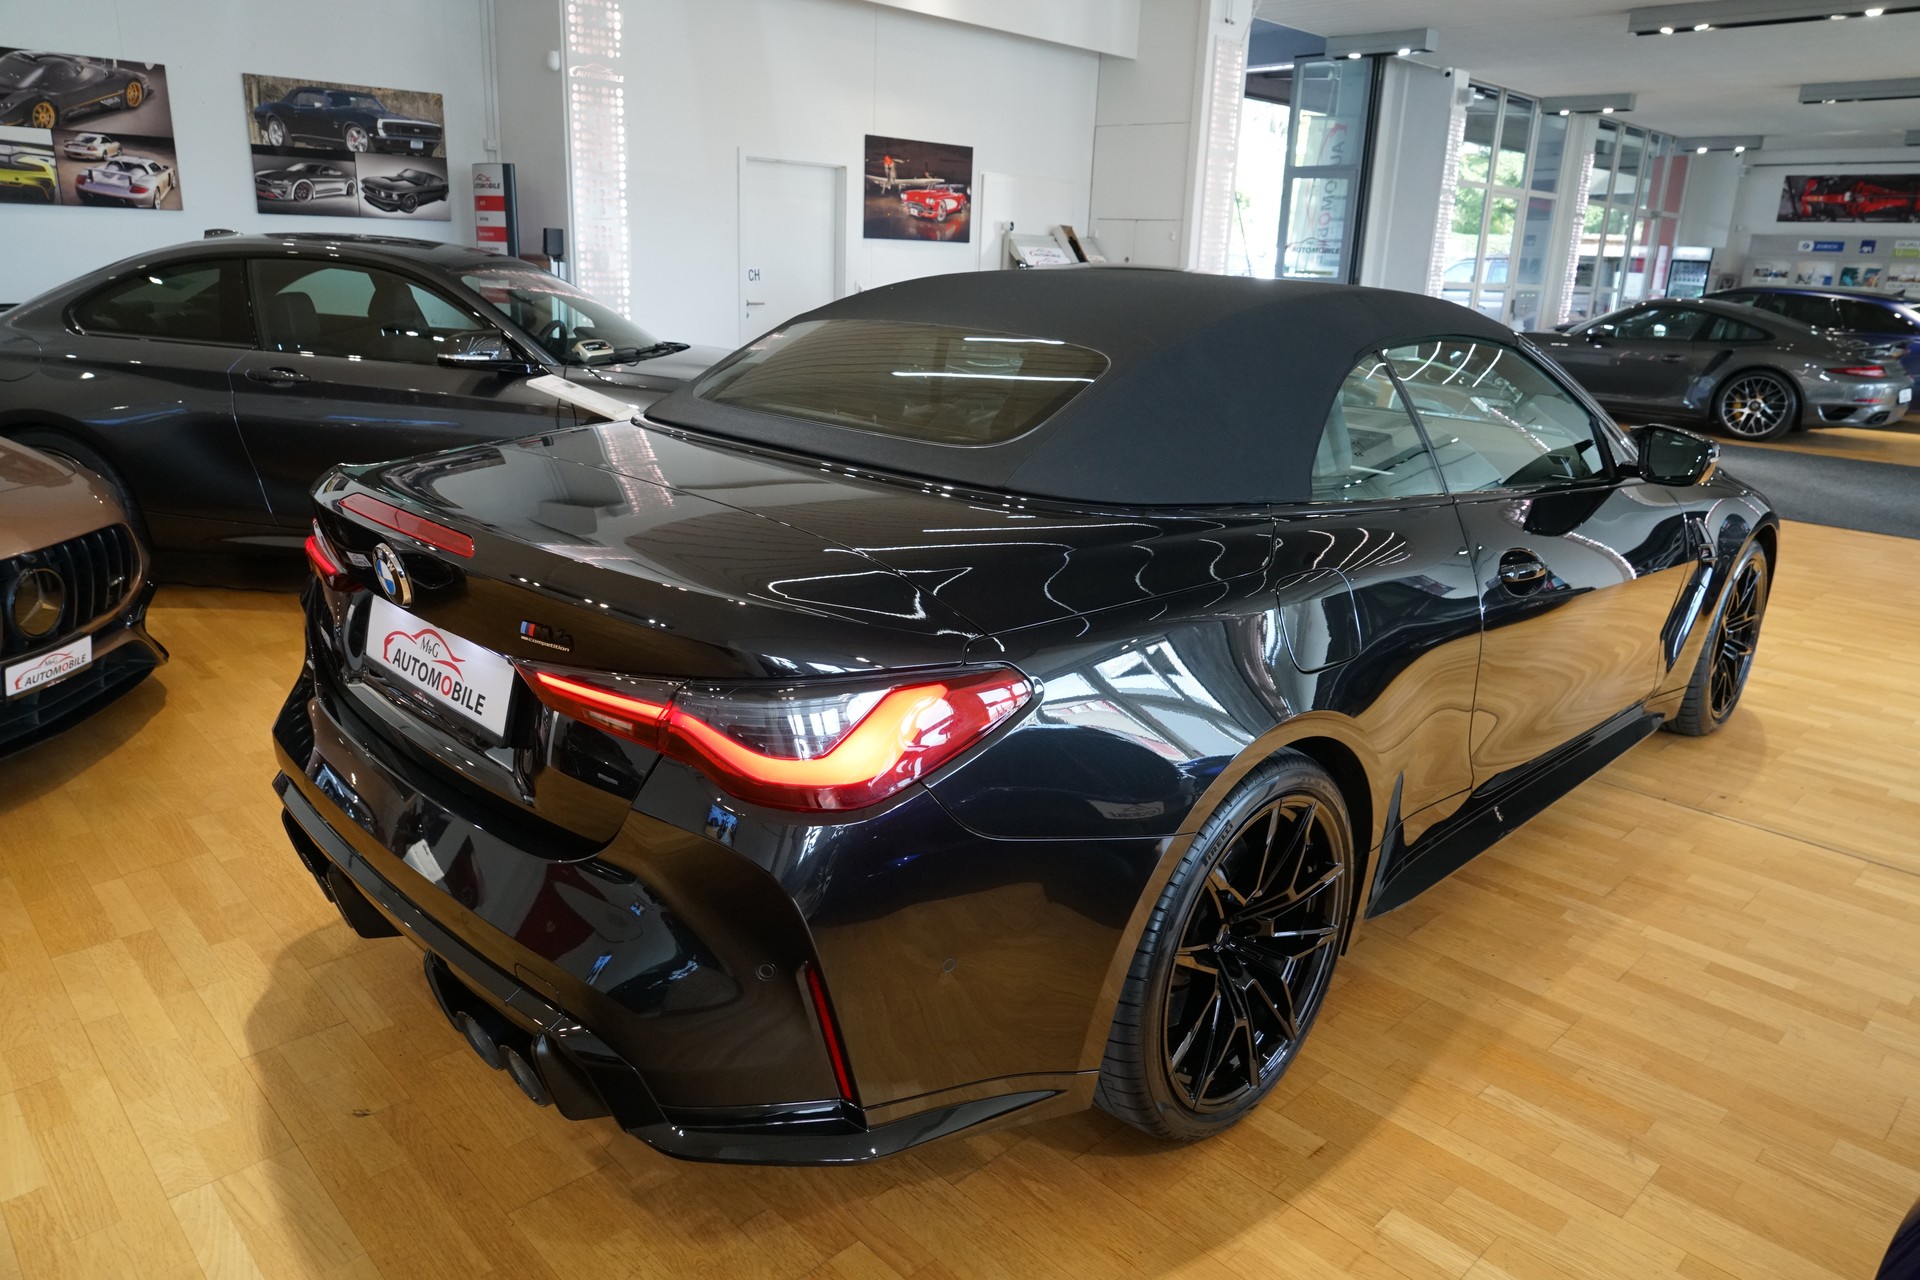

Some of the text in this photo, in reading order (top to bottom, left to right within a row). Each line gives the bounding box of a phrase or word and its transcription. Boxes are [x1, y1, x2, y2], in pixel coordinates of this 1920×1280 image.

[576, 70, 624, 83] AUTOMOBILE
[748, 268, 760, 281] CH
[420, 636, 441, 658] M&G
[24, 654, 86, 688] AUTOMOBILE
[392, 648, 486, 716] AUTOMOBILE
[1201, 819, 1234, 867] PIRELLI
